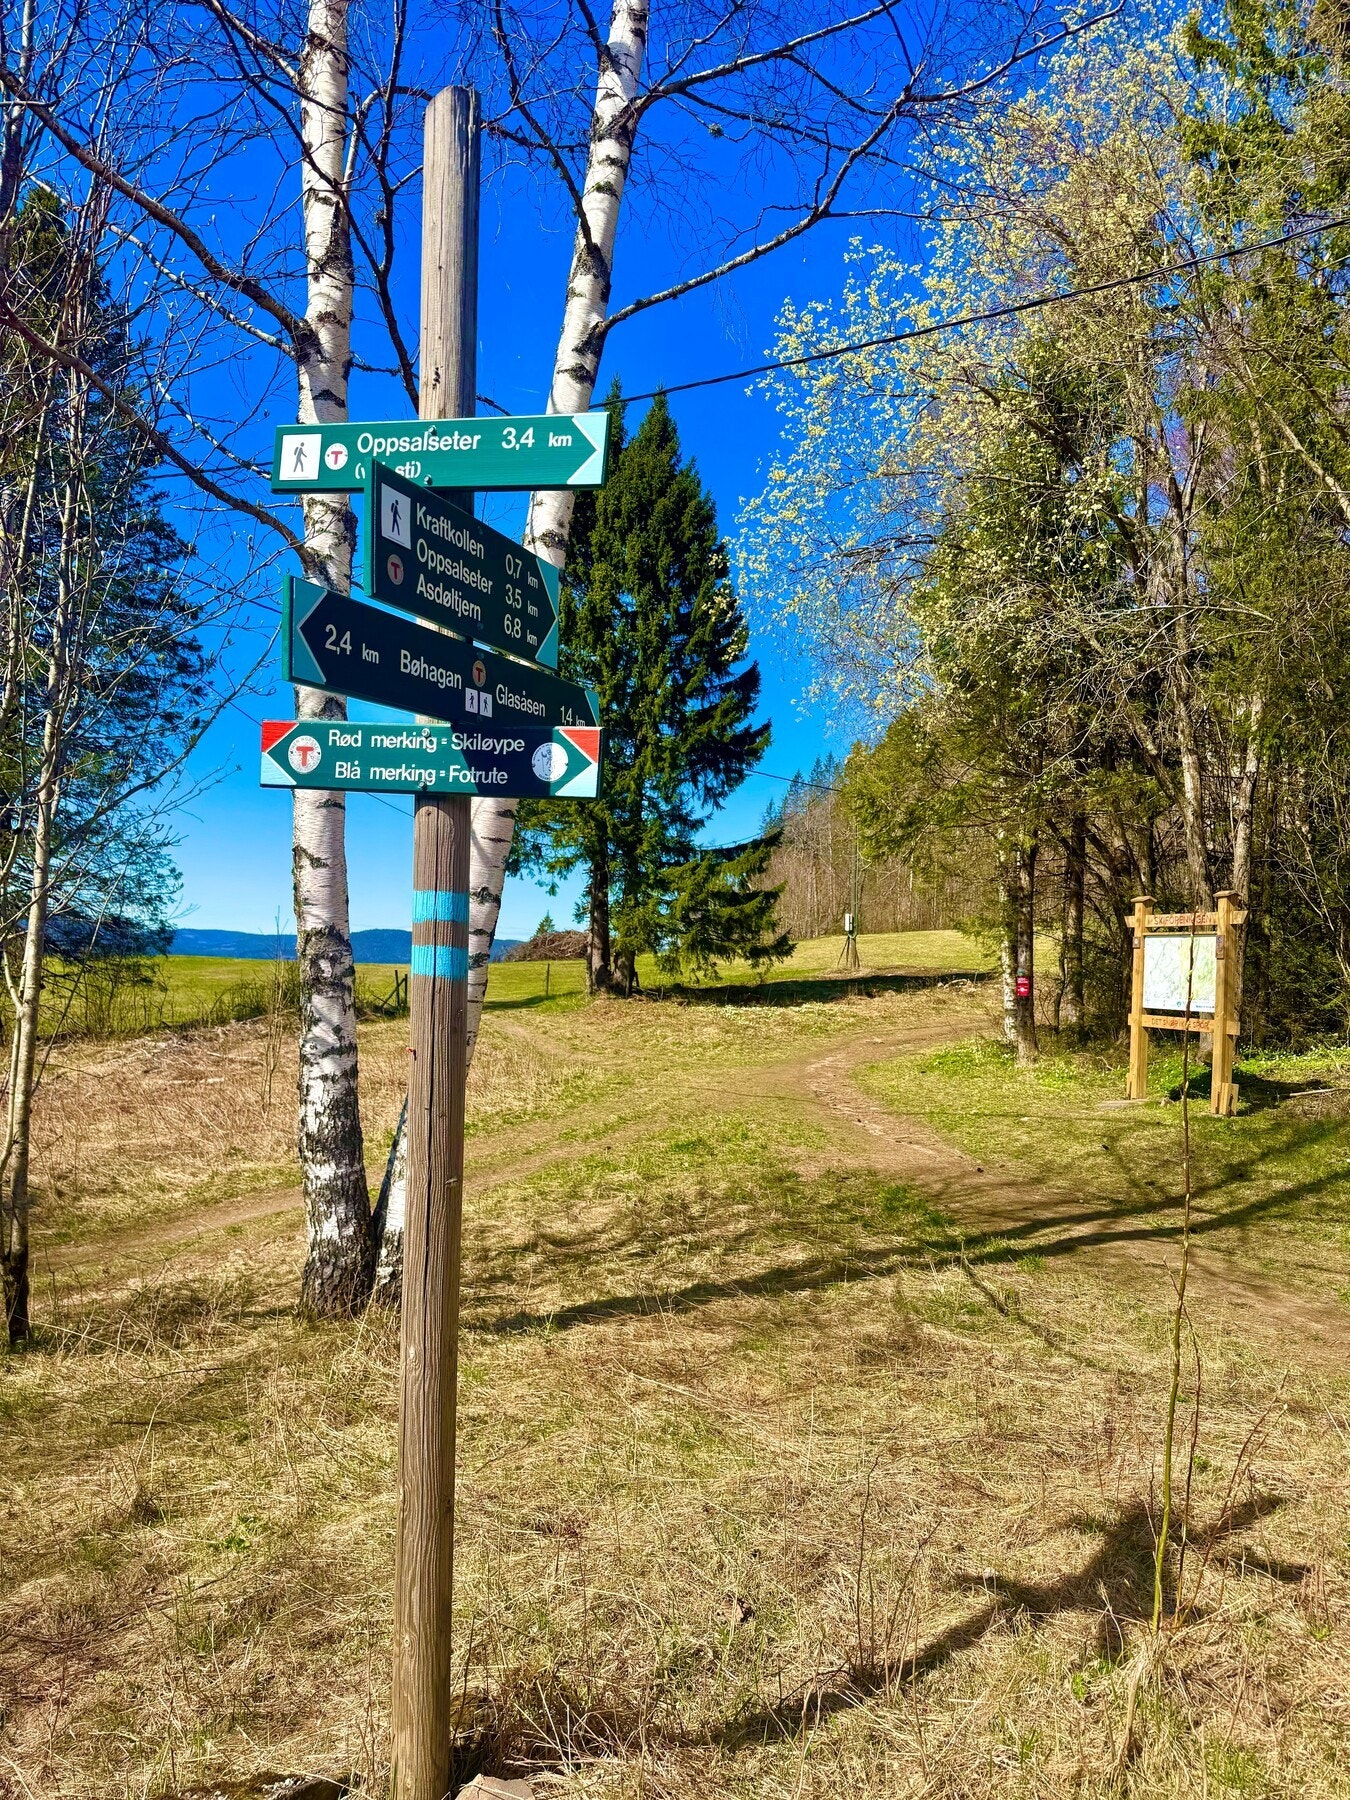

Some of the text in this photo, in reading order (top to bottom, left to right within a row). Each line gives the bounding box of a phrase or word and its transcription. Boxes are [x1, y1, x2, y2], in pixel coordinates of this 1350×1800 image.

[356, 427, 572, 457] Oppsalseter 3,4 km
[394, 460, 421, 479] sti)
[416, 502, 539, 589] Kraftkollen 0,7 km
[416, 538, 539, 617] Oppsalseter 3,5 km
[416, 573, 538, 646] Asdøltjern 6,8 km
[325, 624, 462, 690] 2,4 km Bøhagan
[496, 682, 586, 727] Glasåsen 1,4 km
[328, 729, 362, 748] Rød
[371, 731, 437, 752] merking
[451, 733, 525, 755] Skiløype
[335, 759, 361, 780] Blå
[370, 763, 436, 786] merking
[449, 766, 508, 785] Fotrute
